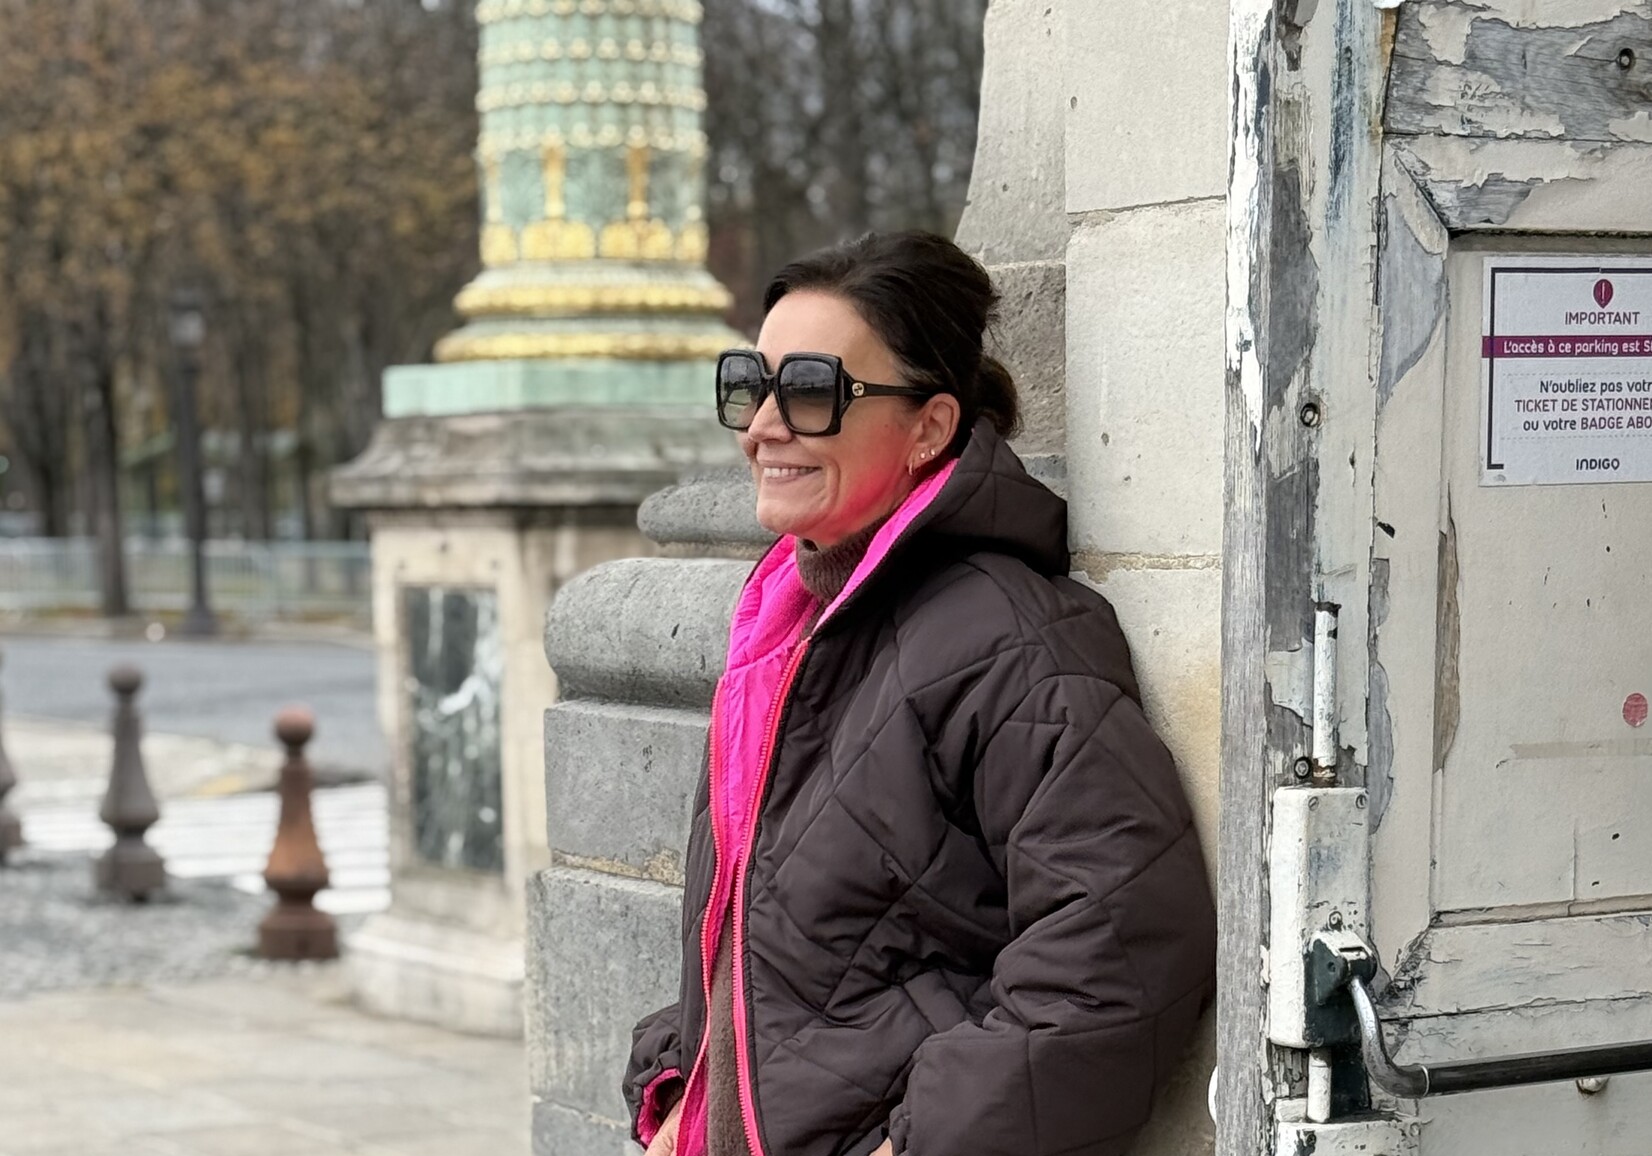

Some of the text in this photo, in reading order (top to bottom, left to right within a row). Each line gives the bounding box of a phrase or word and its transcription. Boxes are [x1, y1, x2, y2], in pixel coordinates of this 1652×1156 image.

[1565, 311, 1640, 325] IMPORTANT
[1504, 339, 1652, 356] L'accès à ce parking est S
[1540, 378, 1597, 393] N'oubliez
[1600, 382, 1623, 396] pas
[1514, 397, 1652, 412] TICKET DE STATIONNE
[1523, 420, 1539, 431] ou
[1543, 417, 1577, 431] votre
[1581, 416, 1623, 430] BADGE
[1576, 458, 1620, 471] INDIGO
